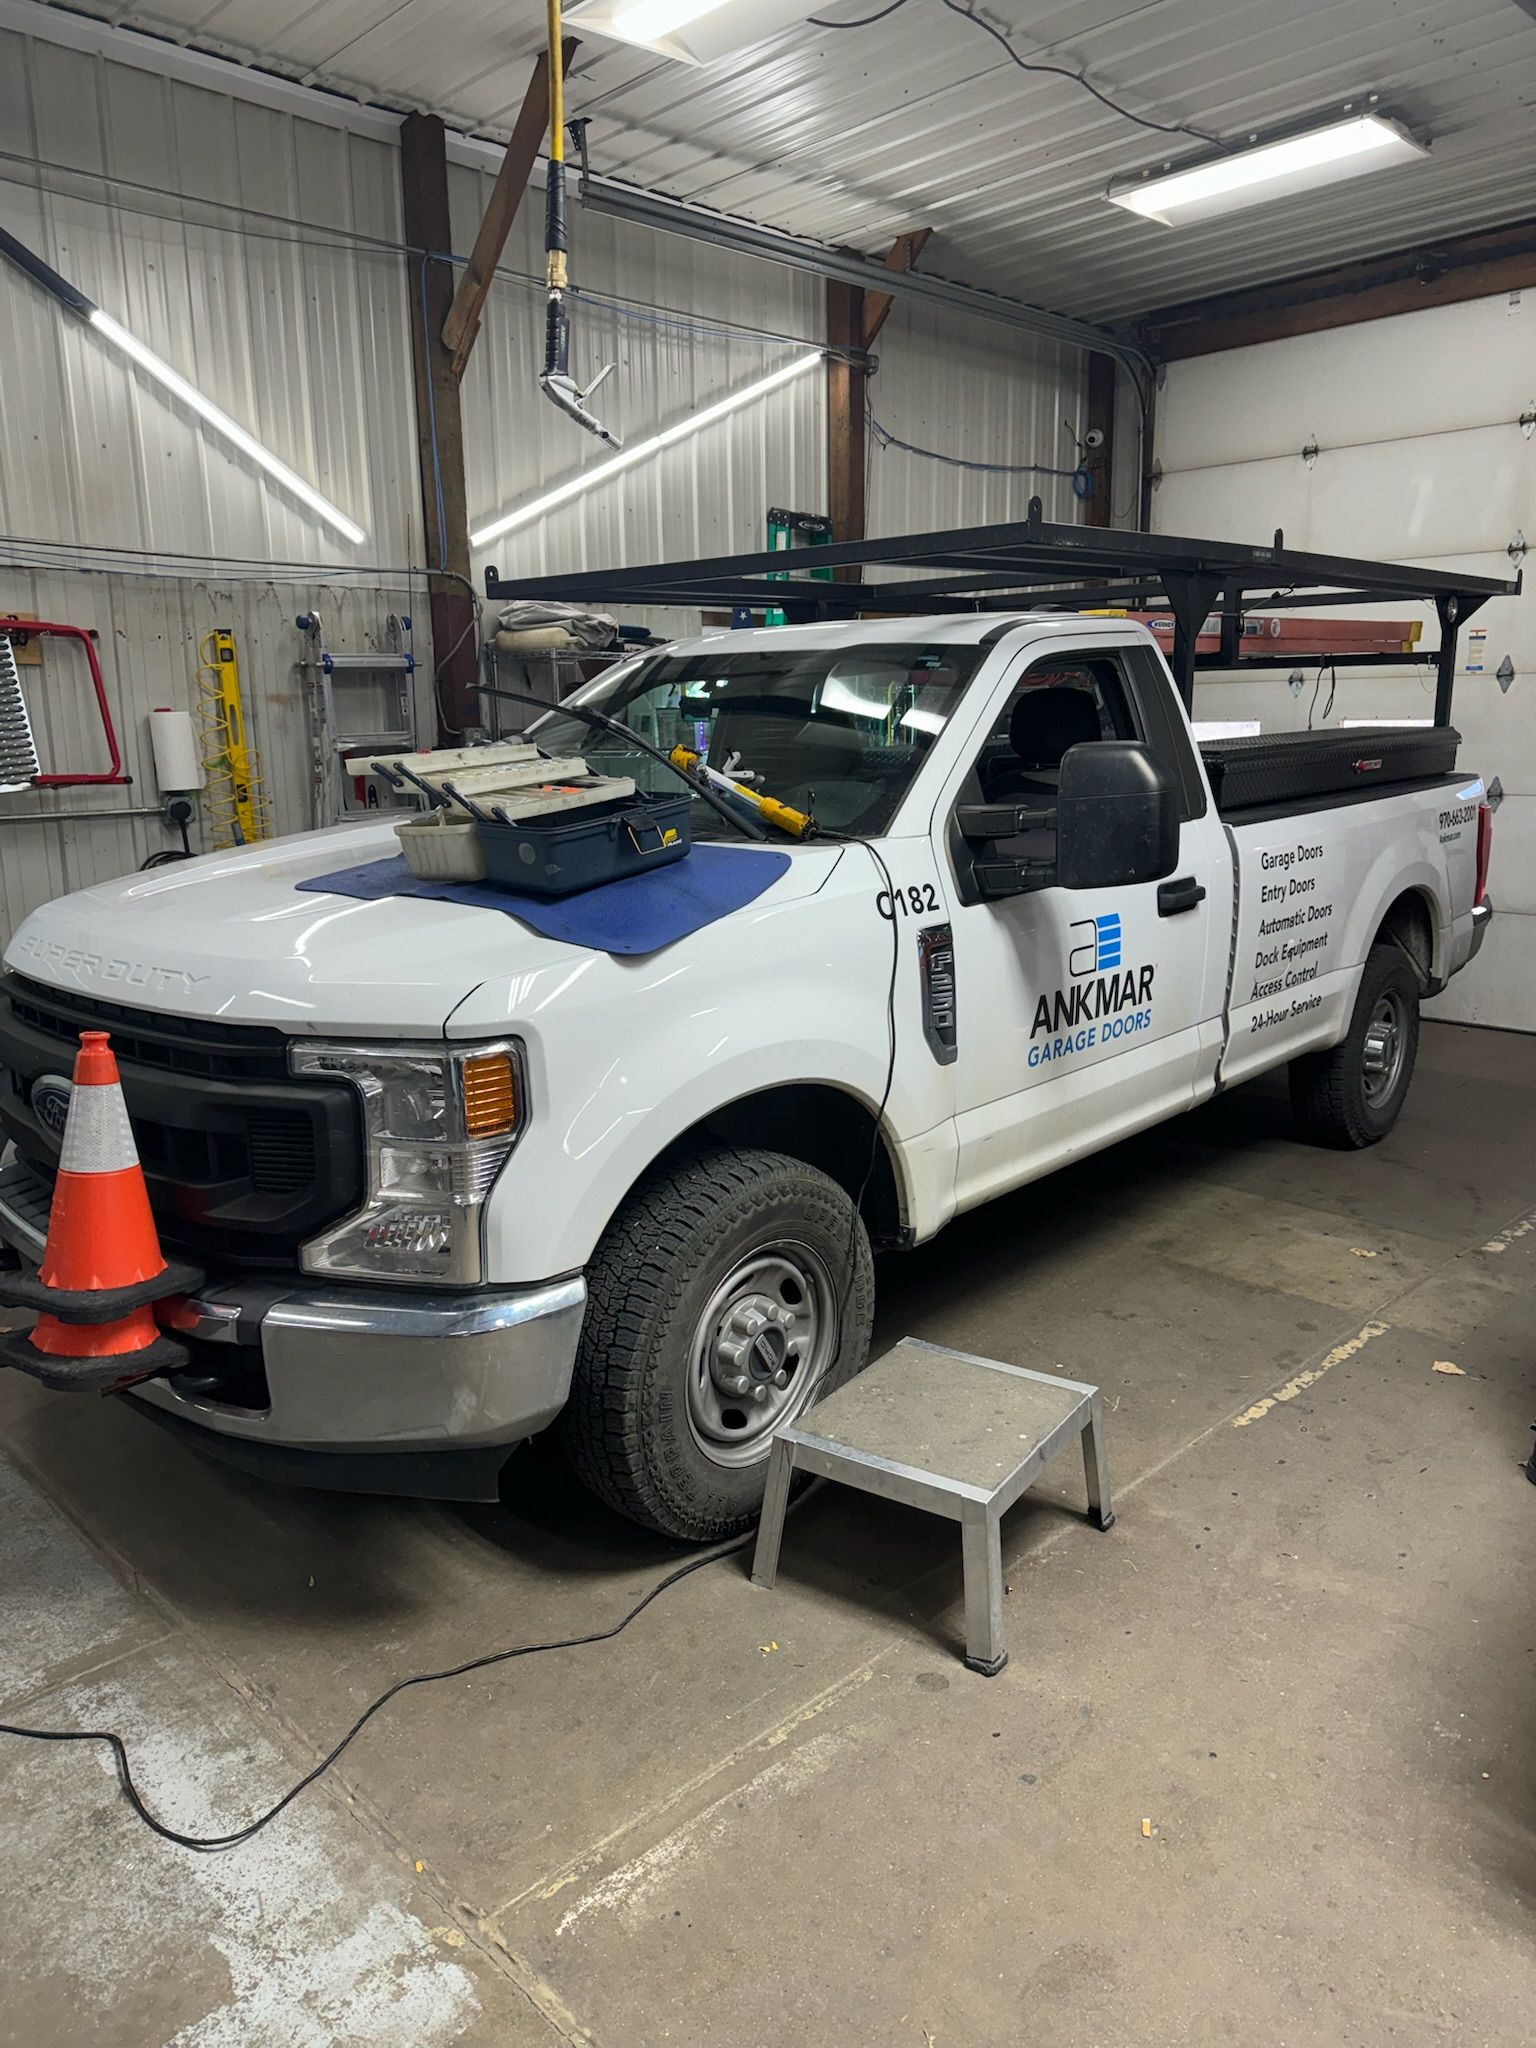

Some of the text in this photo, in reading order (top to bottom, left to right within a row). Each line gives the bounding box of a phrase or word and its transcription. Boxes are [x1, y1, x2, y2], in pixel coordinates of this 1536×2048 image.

[1261, 844, 1323, 871] Garage Doors
[1261, 877, 1315, 903] Entry Doors
[1258, 904, 1332, 937] Automatic Doors
[19, 936, 211, 995] SUPER DUTY
[1255, 931, 1328, 969] Dock Equipment
[1250, 961, 1318, 1000] Access Control
[1030, 964, 1155, 1039] ANKMAR
[1251, 994, 1322, 1033] 24-Hour Service
[1027, 1009, 1151, 1067] GARAGE DOORS
[659, 1392, 697, 1502] TERRAIN
